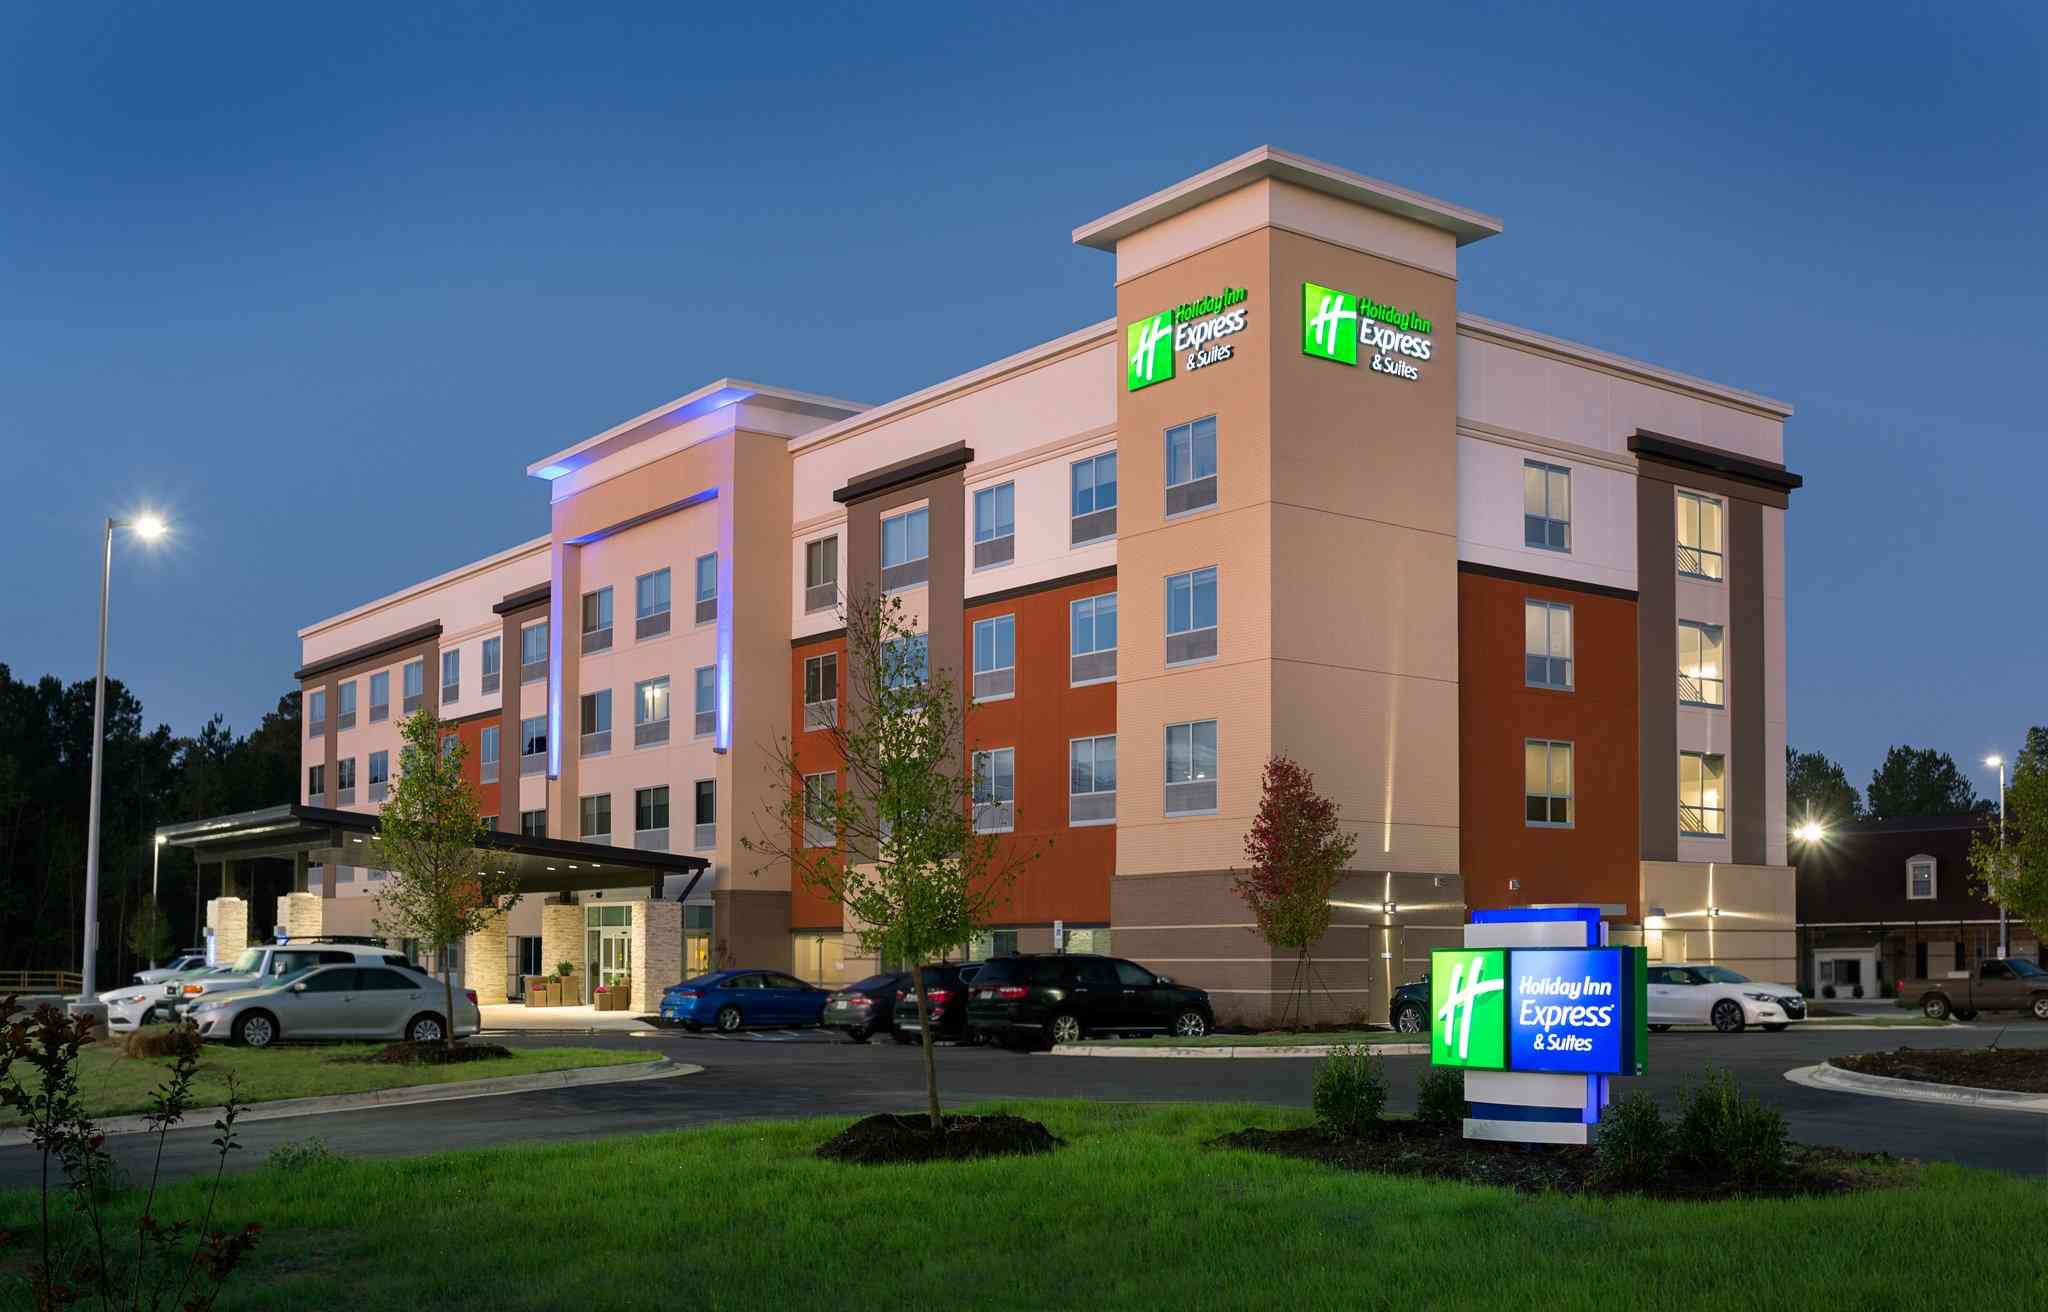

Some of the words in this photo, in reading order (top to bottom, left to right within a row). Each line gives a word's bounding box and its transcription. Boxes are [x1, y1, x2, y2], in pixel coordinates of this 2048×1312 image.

[1176, 296, 1224, 322] Holiday
[1223, 288, 1246, 305] Inn
[1360, 297, 1409, 330] Holiday
[1410, 311, 1431, 333] Inn
[1175, 309, 1246, 351] Express
[1360, 318, 1431, 360] Express
[1186, 353, 1197, 370] &
[1197, 345, 1232, 367] Suites
[1372, 354, 1382, 370] &
[1383, 357, 1418, 379] Suites
[1519, 976, 1582, 1000] Holiday
[1583, 976, 1612, 995] Inn
[1519, 999, 1613, 1032] Express
[1533, 1033, 1544, 1050] &
[1546, 1034, 1593, 1051] Suites
